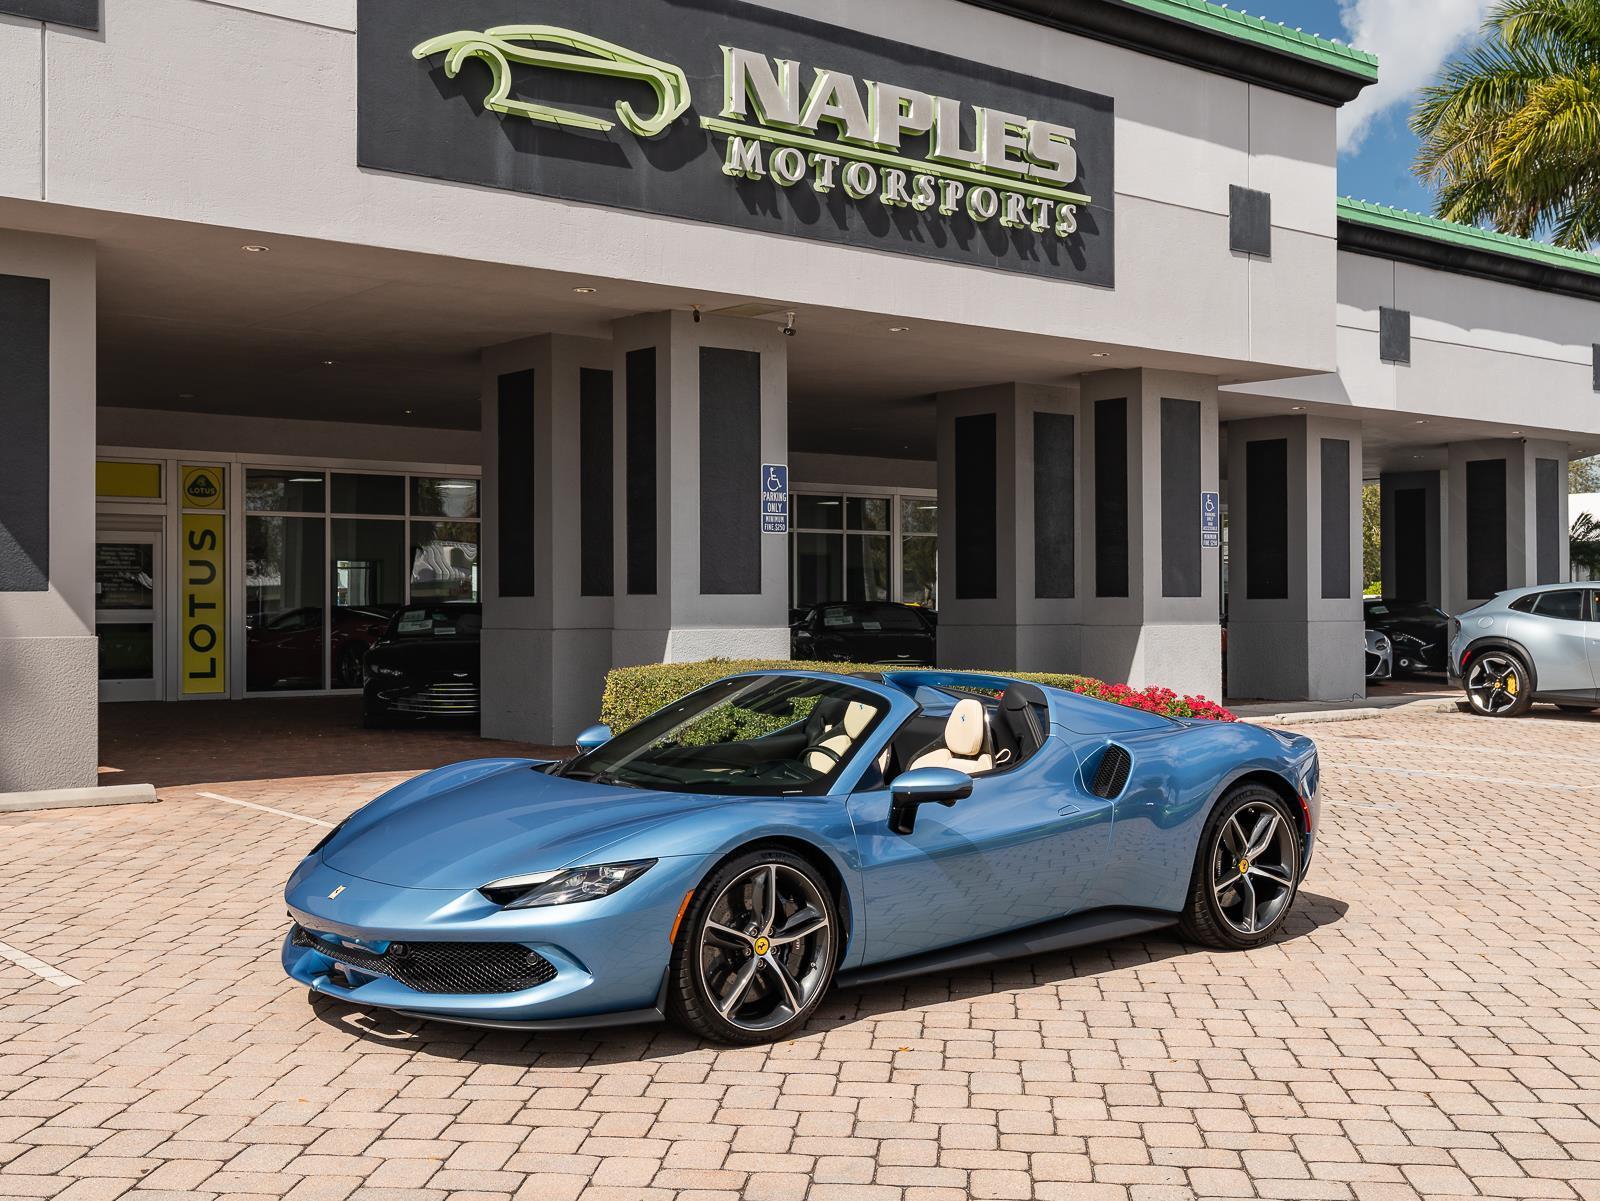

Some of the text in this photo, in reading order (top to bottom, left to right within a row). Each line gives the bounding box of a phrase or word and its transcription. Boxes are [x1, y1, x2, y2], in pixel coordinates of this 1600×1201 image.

[719, 45, 1077, 185] NAPLES
[722, 136, 1077, 237] MOTORSPORTS
[763, 492, 787, 502] PARKING
[768, 502, 782, 512] ONLY
[188, 528, 216, 678] LOTUS
